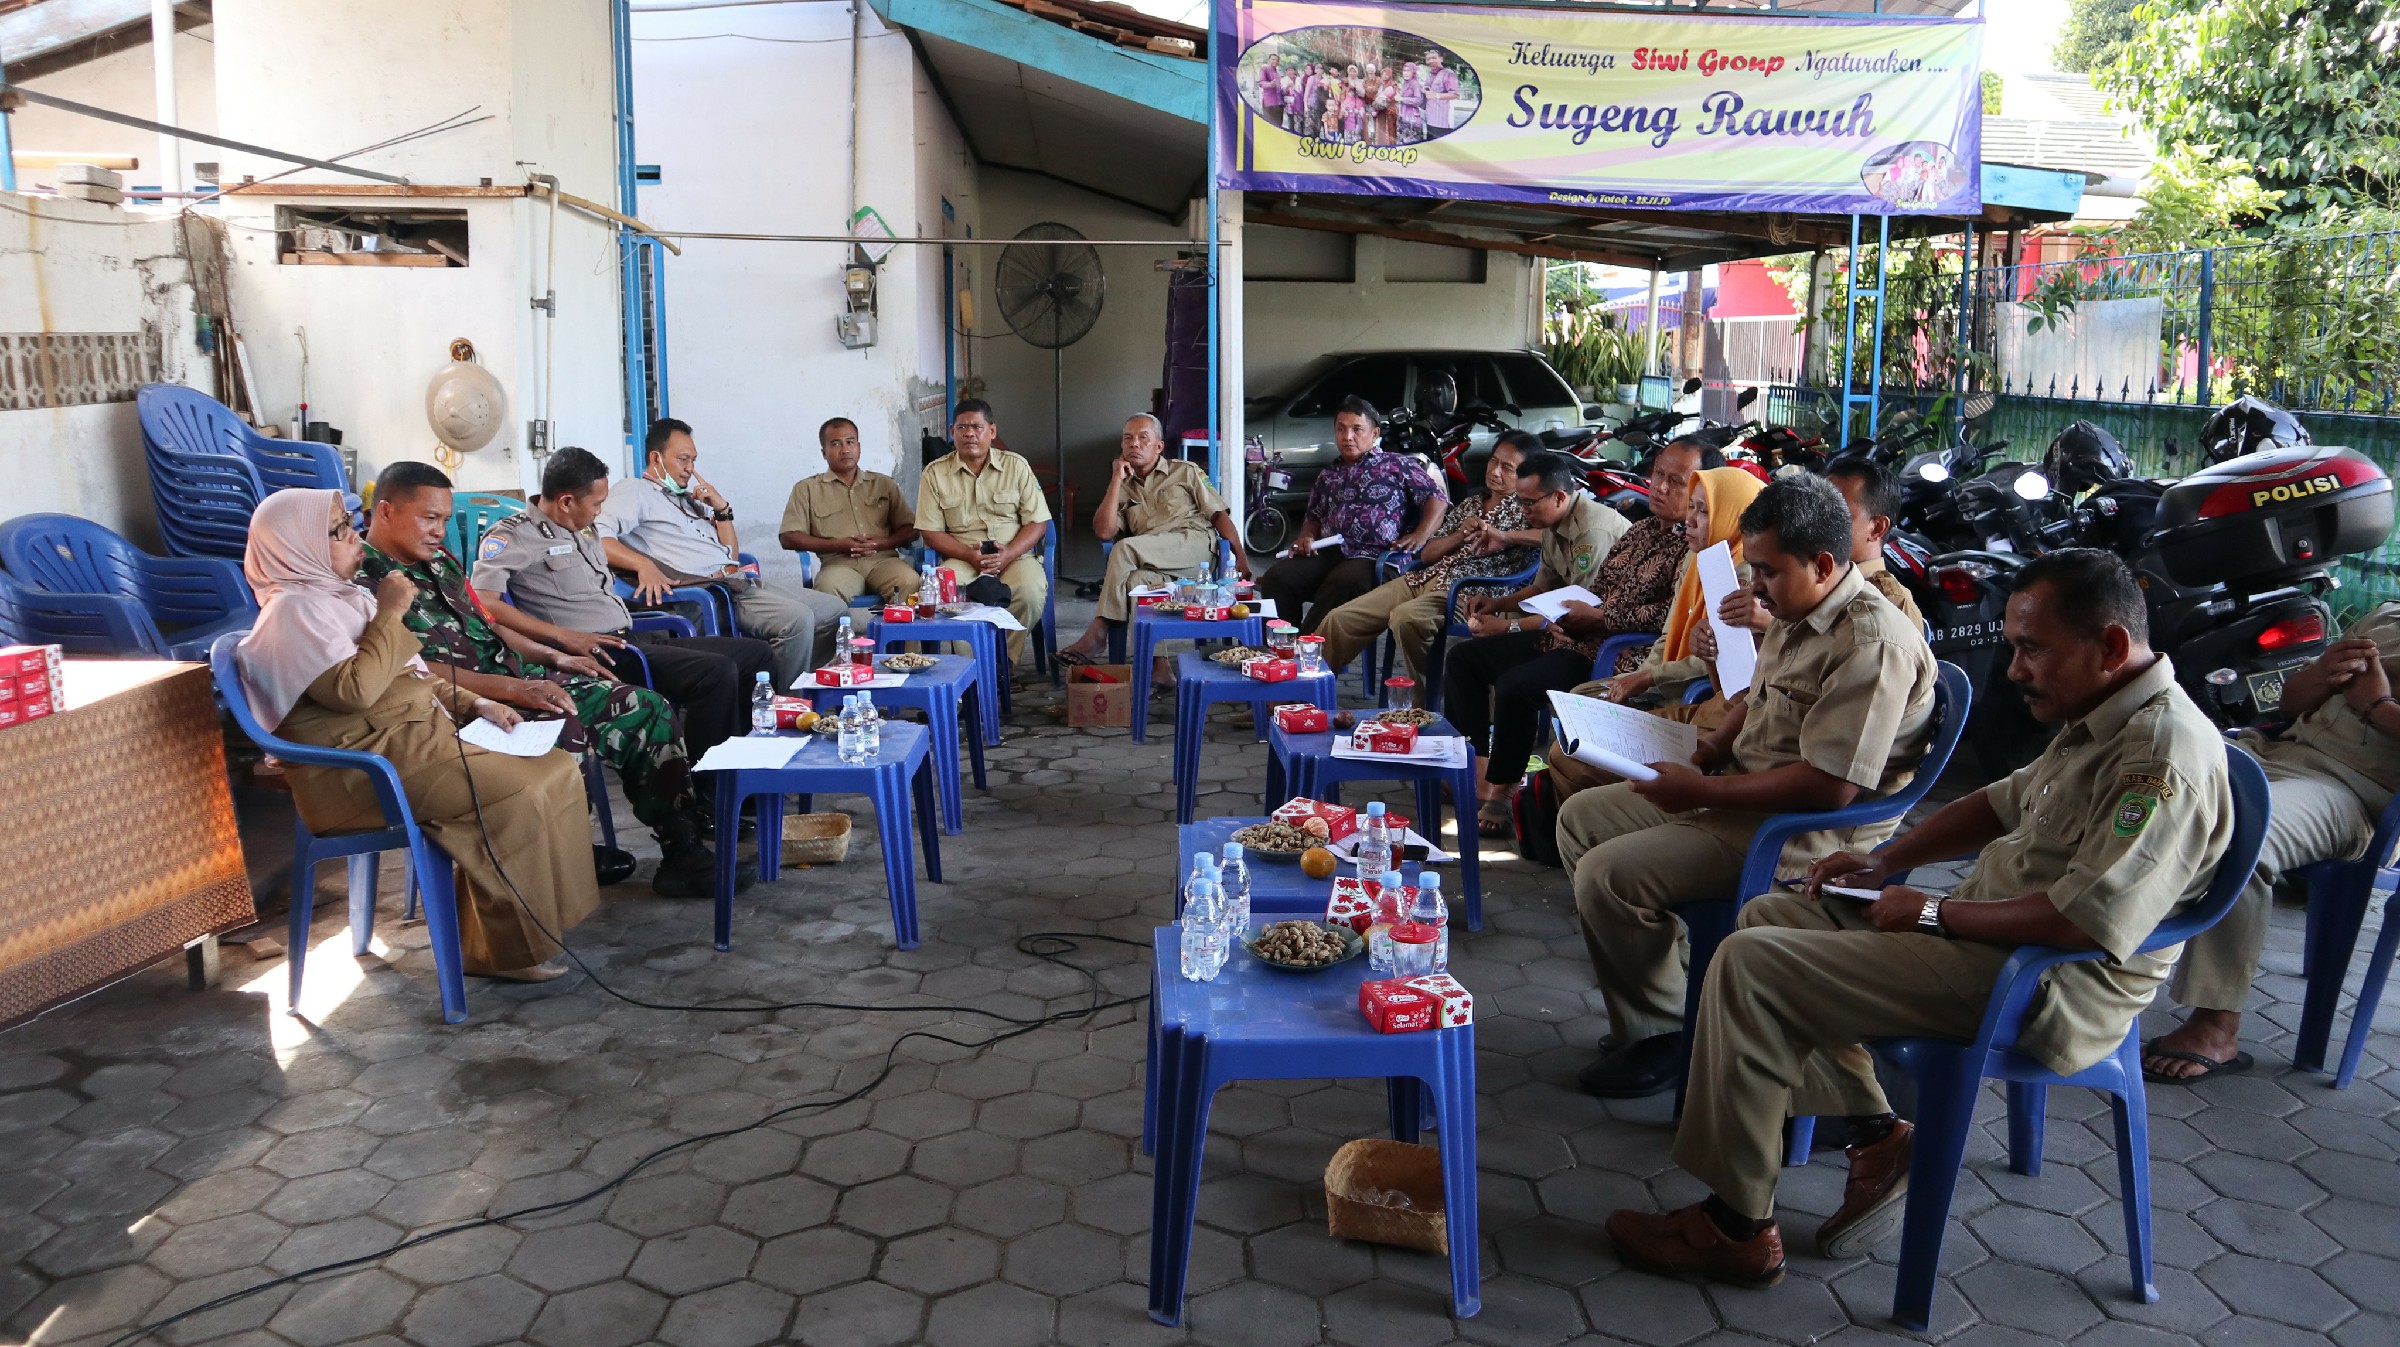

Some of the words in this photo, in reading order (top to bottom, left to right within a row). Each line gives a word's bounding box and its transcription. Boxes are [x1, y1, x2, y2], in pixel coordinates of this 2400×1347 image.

[1507, 41, 1616, 76] Keluarga
[1631, 46, 1690, 72] Siwi
[1696, 48, 1786, 78] Group
[1795, 48, 1922, 80] Ngaturaken
[1505, 84, 1681, 149] Sugeng
[1695, 90, 1877, 138] Rawuh
[1298, 136, 1345, 159] Siwi
[1350, 140, 1418, 168] Group
[1548, 191, 1584, 204] Design
[2253, 474, 2341, 507] POLISI
[1950, 623, 1981, 639] 2829
[1988, 620, 2003, 633] UJ
[1392, 1021, 1419, 1030] Selamat
